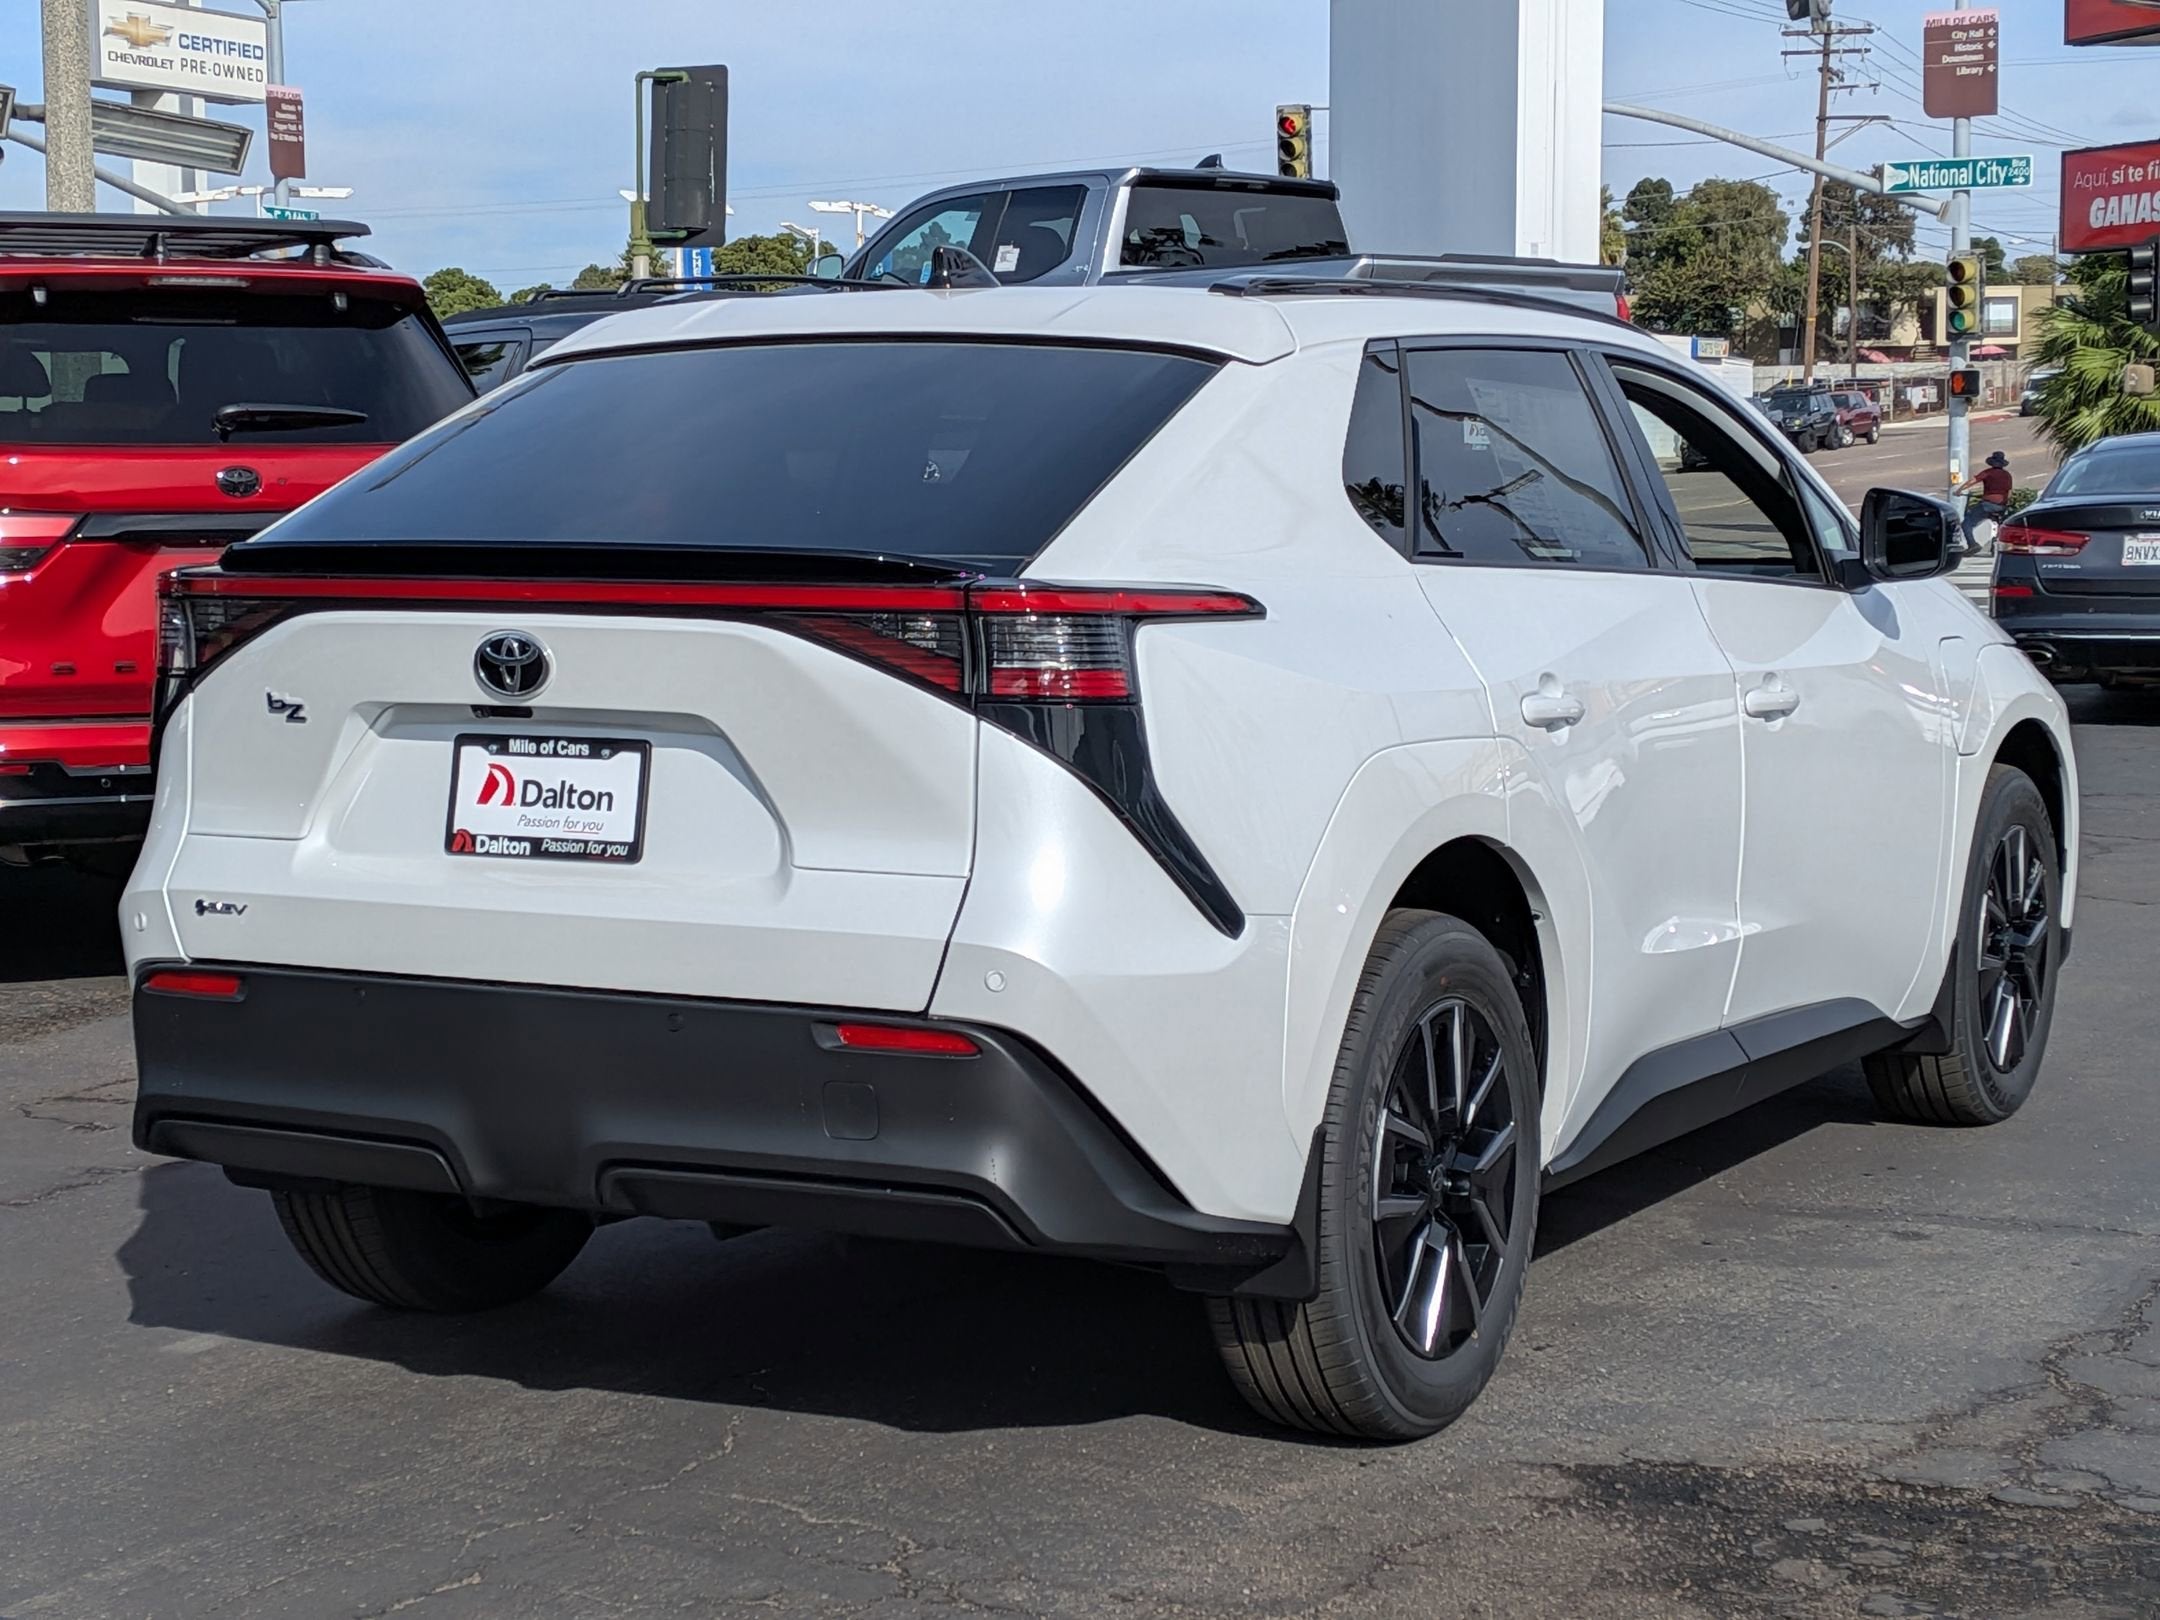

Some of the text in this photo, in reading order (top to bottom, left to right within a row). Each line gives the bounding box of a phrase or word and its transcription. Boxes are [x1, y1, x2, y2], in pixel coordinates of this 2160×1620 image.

[178, 33, 264, 61] CERTIFIED
[1951, 31, 1967, 41] City
[108, 50, 174, 71] CHEVROLET
[180, 57, 264, 83] PRE-OWNED
[1956, 66, 1984, 76] Library
[1908, 162, 1973, 188] National
[1976, 160, 2008, 186] City
[2008, 167, 2030, 177] 2400
[2073, 167, 2109, 191] Aquí,
[2112, 164, 2126, 185] sí
[2128, 165, 2144, 182] te
[2089, 190, 2160, 229] GANAS
[2126, 546, 2160, 560] 8NVX
[508, 738, 590, 756] Mile of Cars
[520, 779, 614, 812] Dalton
[517, 814, 604, 833] Passion for you
[475, 835, 630, 858] Dalton Passion for you
